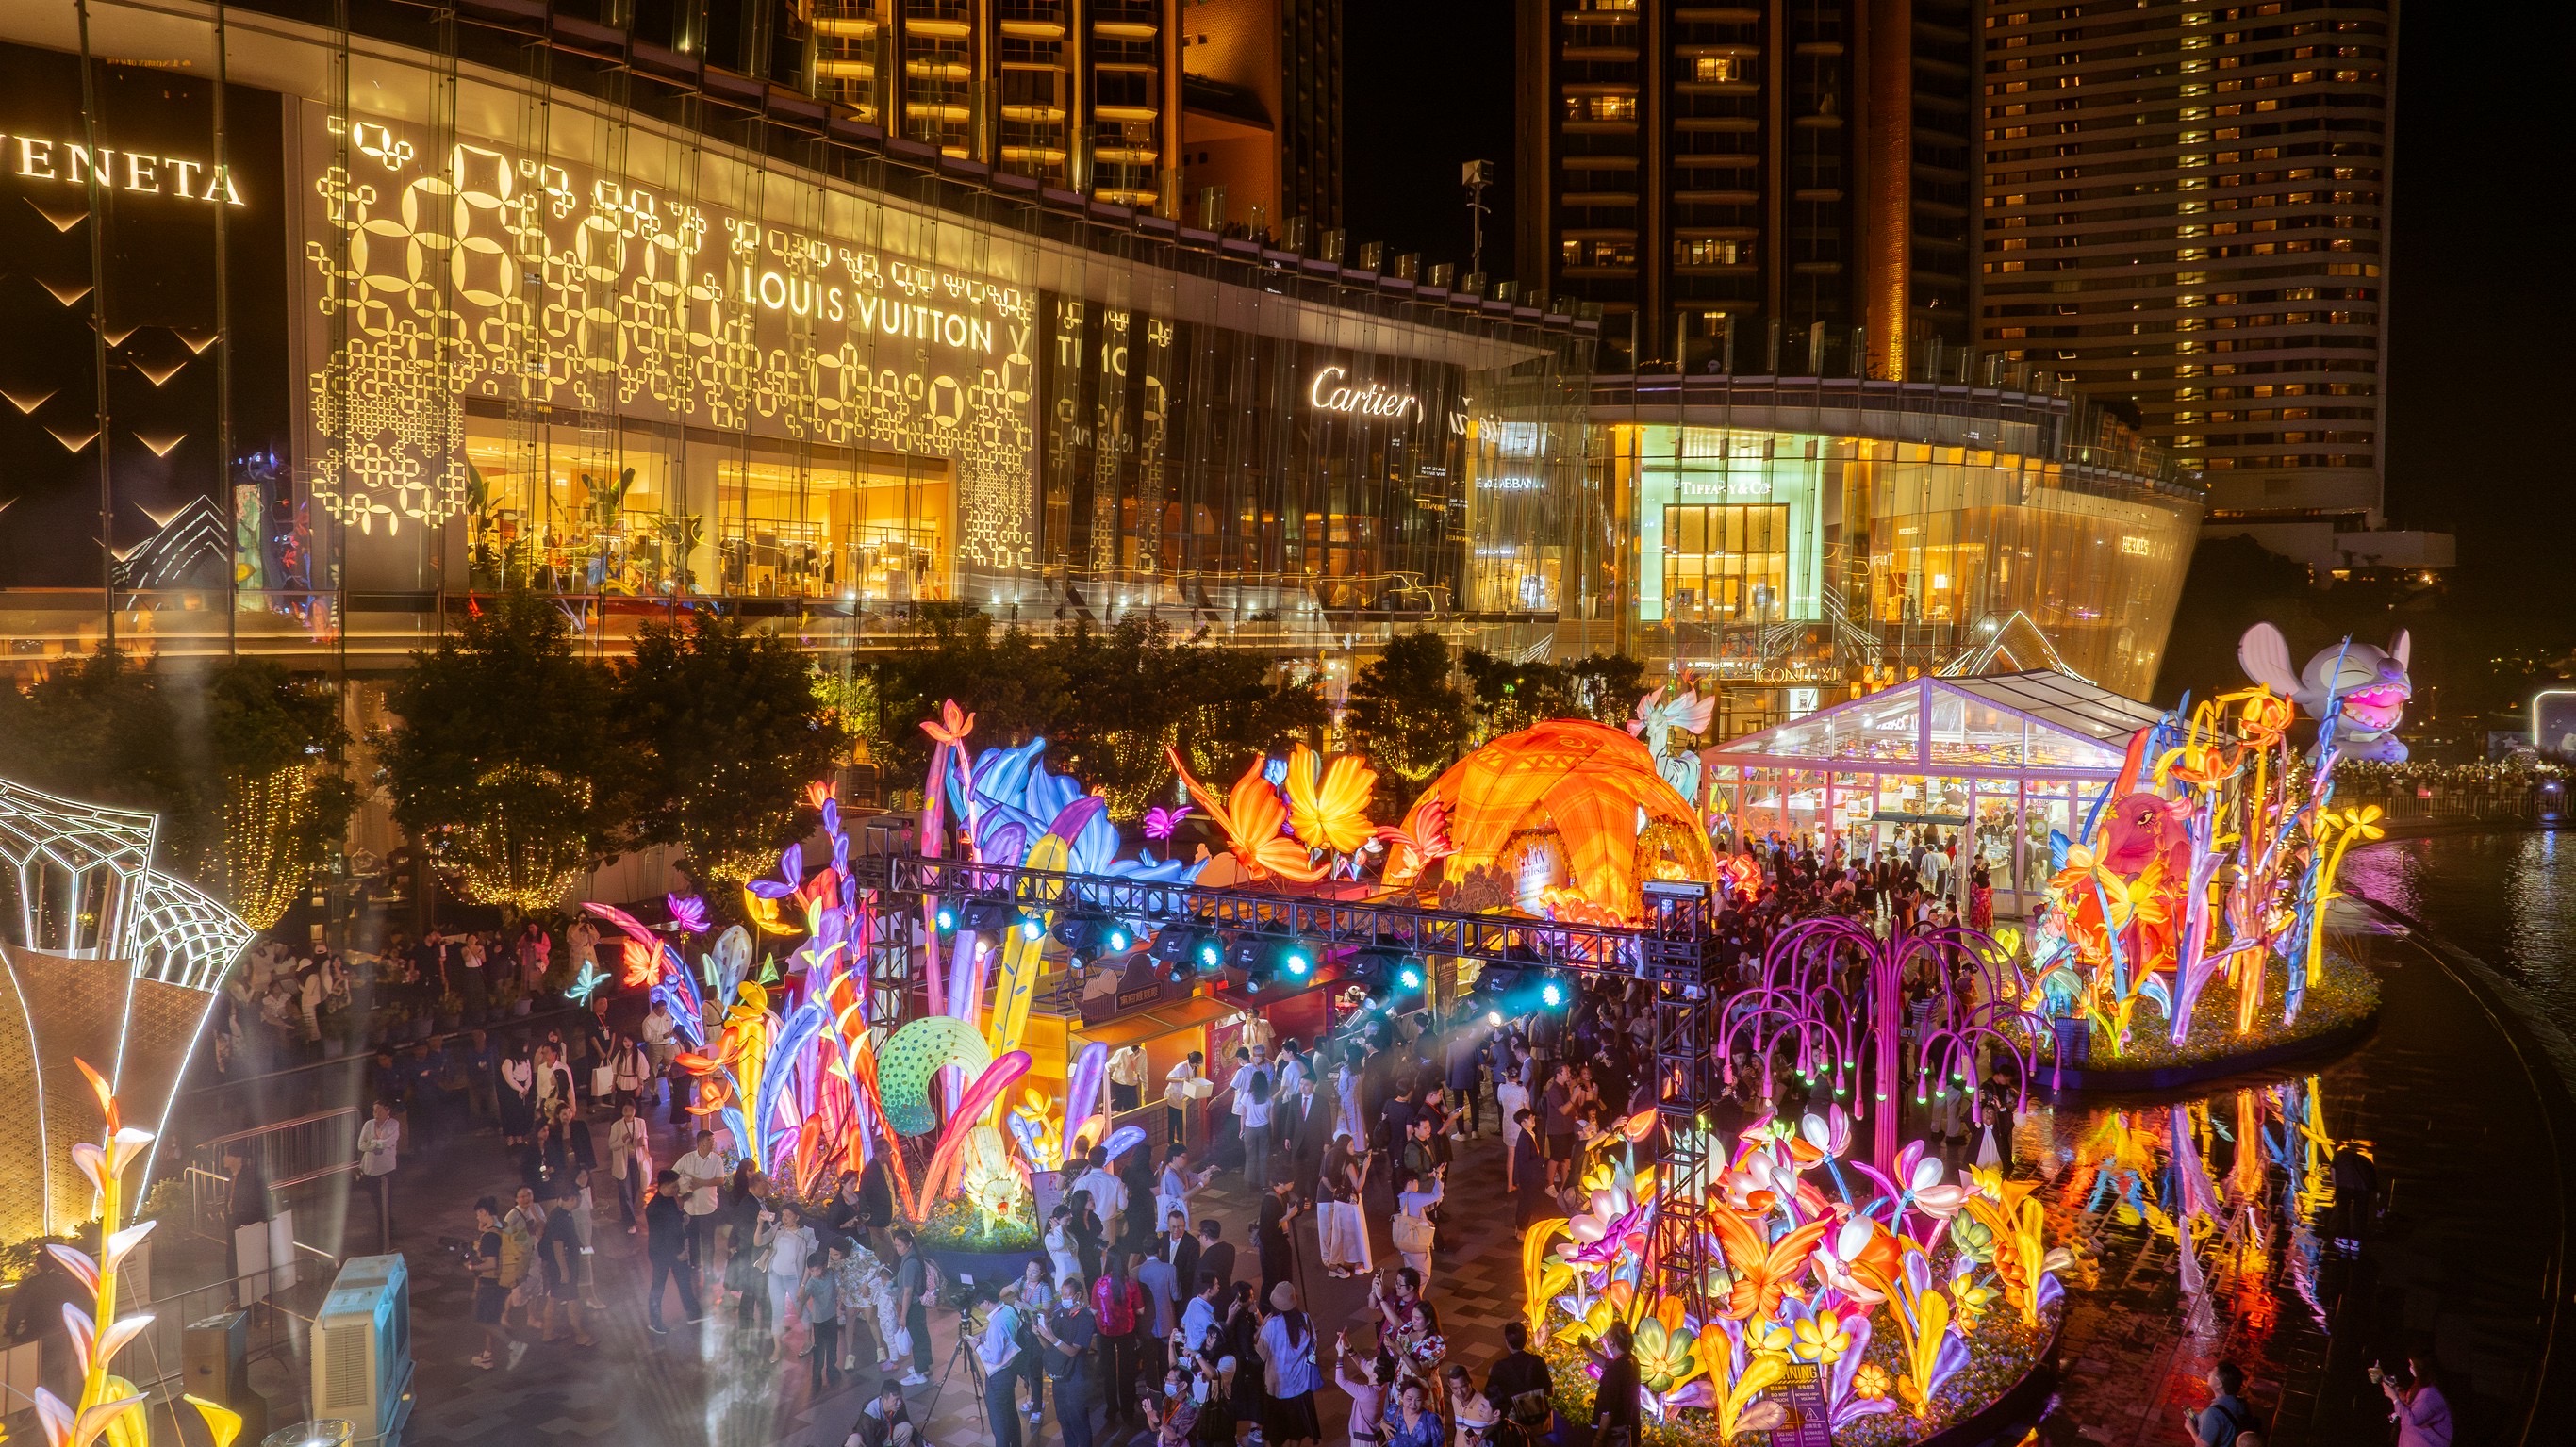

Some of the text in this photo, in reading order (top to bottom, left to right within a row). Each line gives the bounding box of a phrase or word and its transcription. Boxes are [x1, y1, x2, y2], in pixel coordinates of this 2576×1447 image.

[0, 134, 245, 206] ENETA
[743, 265, 991, 355] LOUIS VUITTON
[1311, 366, 1416, 418] Cartier
[1681, 481, 1742, 495] TIFFAY
[1783, 1366, 1818, 1379] RNING
